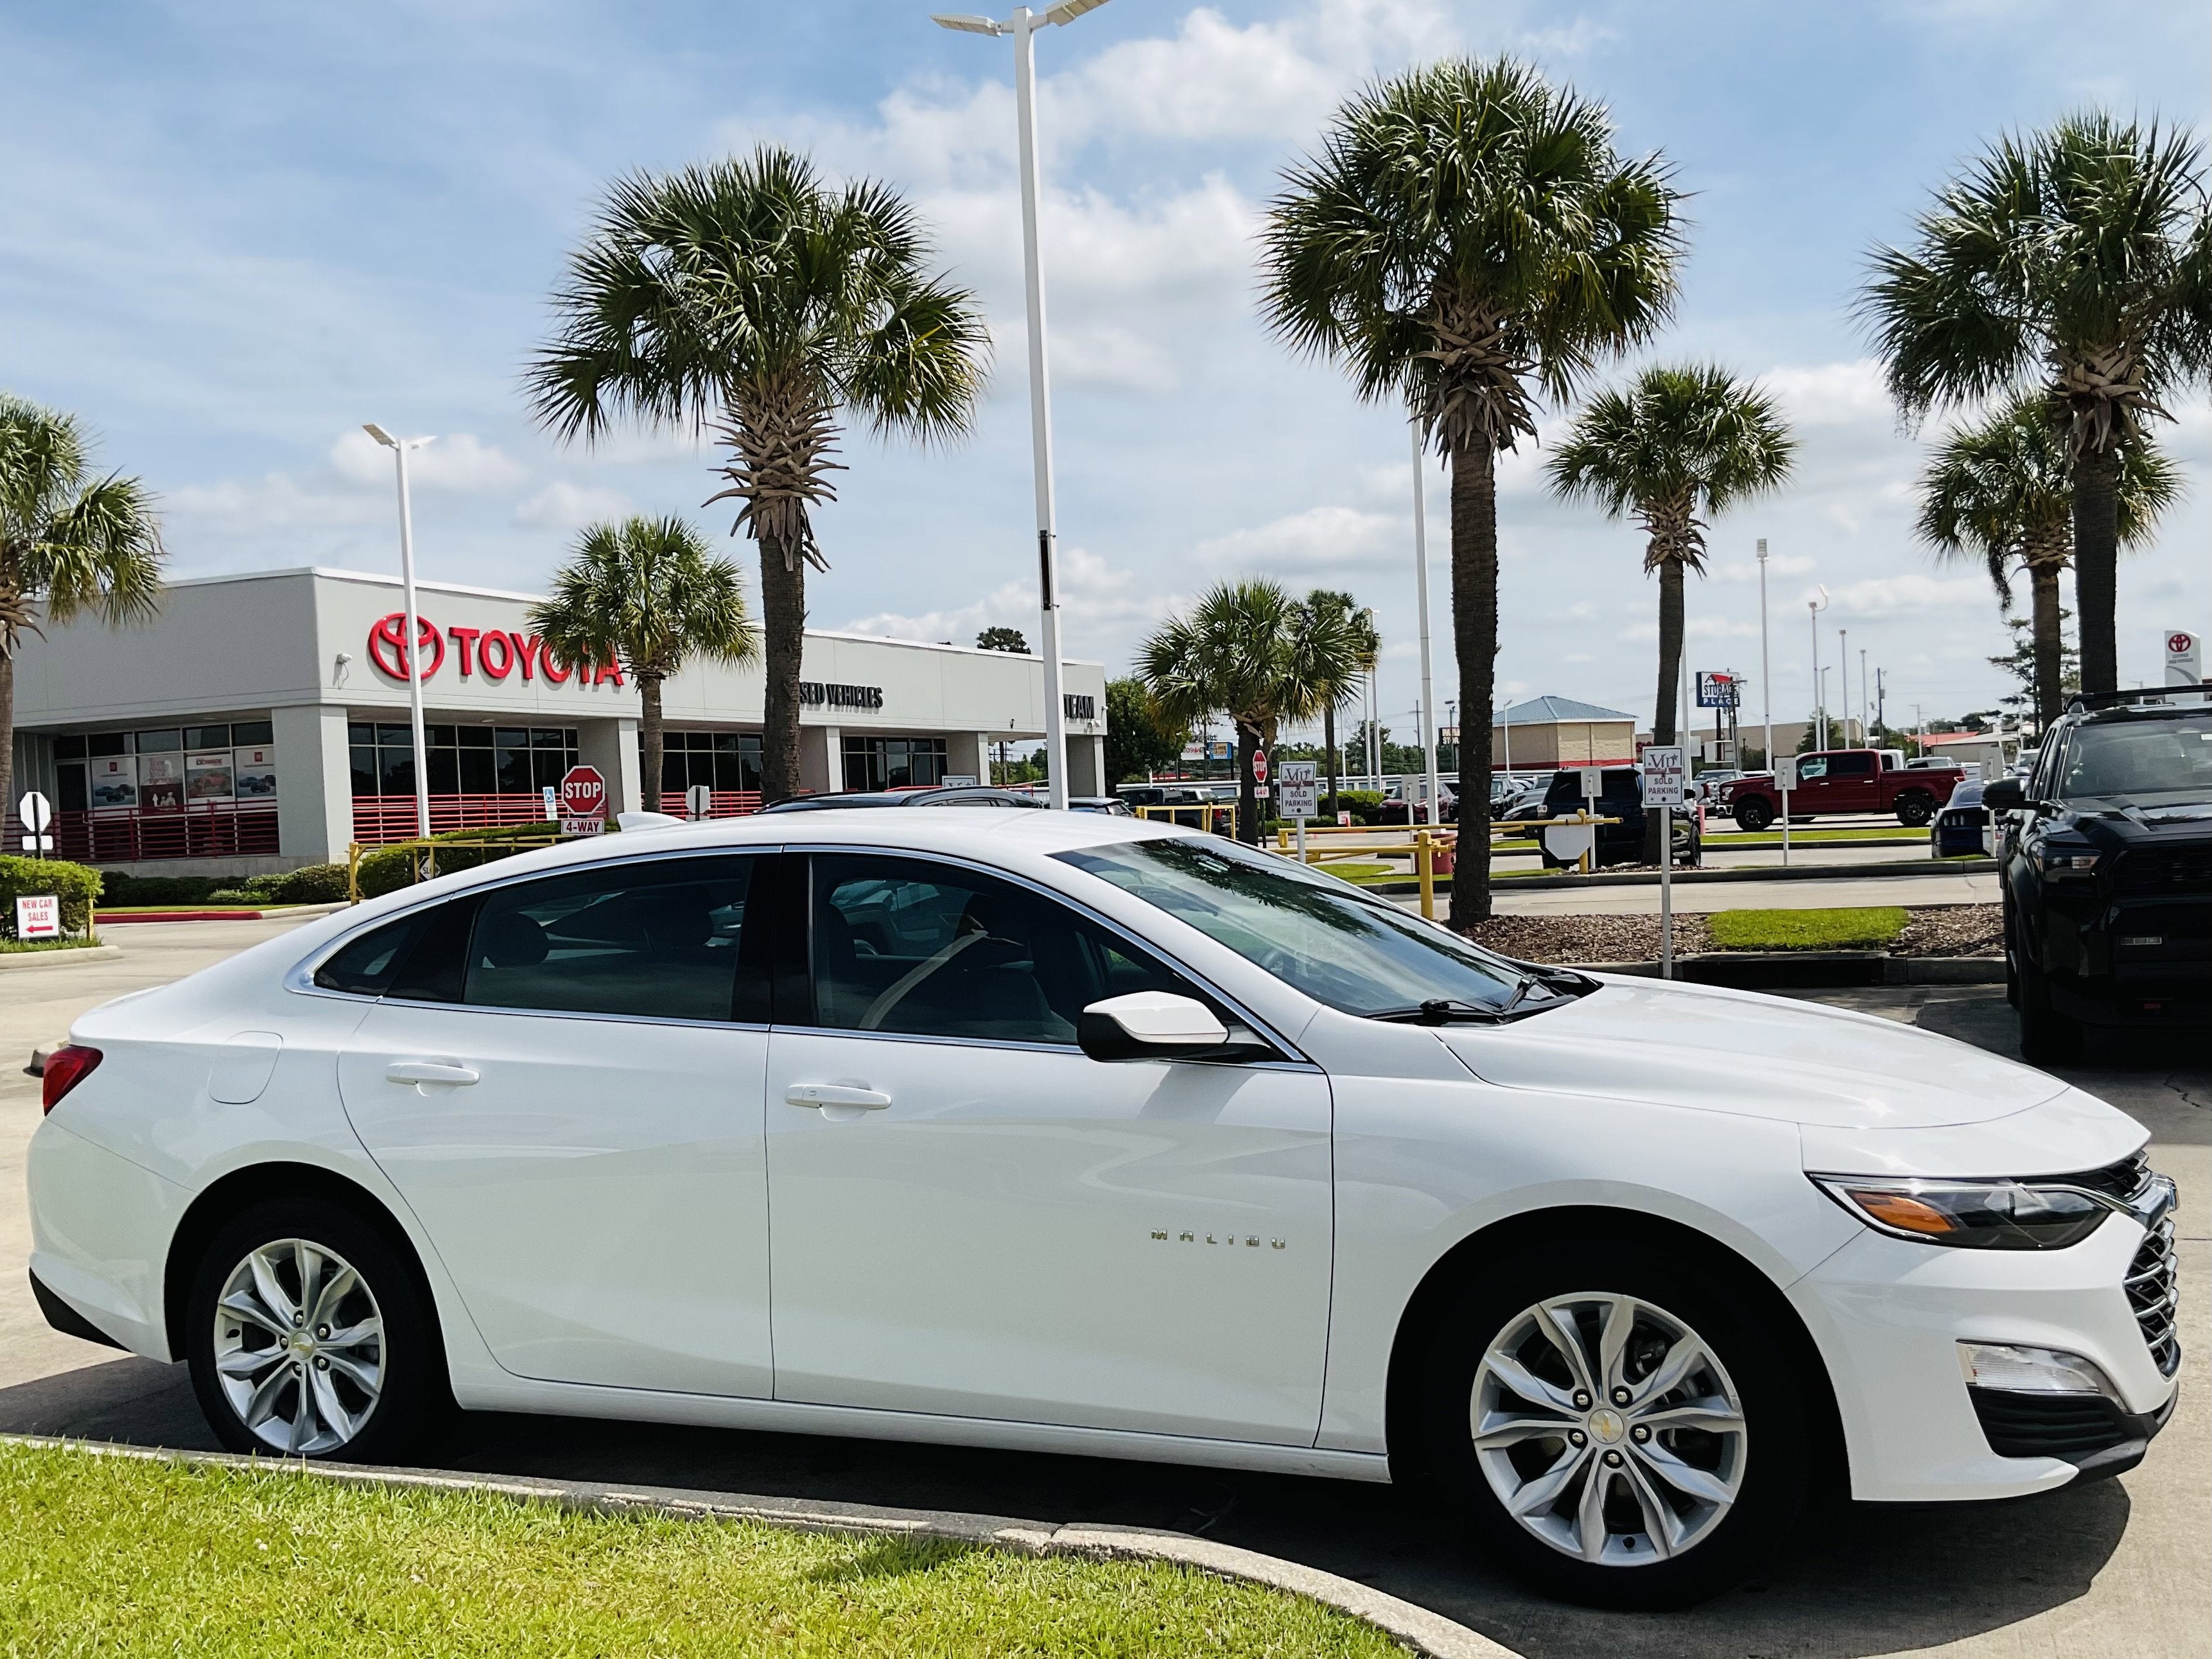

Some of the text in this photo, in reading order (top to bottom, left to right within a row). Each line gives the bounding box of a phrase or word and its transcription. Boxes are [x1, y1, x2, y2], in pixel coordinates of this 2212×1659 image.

[799, 682, 883, 708] SED VEHICLES
[1063, 694, 1094, 718] TEAM
[1254, 761, 1266, 772] STOP
[565, 782, 602, 799] STOP
[566, 822, 600, 832] 4-WAY
[22, 899, 53, 909] NEW CAR
[28, 912, 48, 921] SALES
[1151, 1228, 1285, 1249] MALIBU
